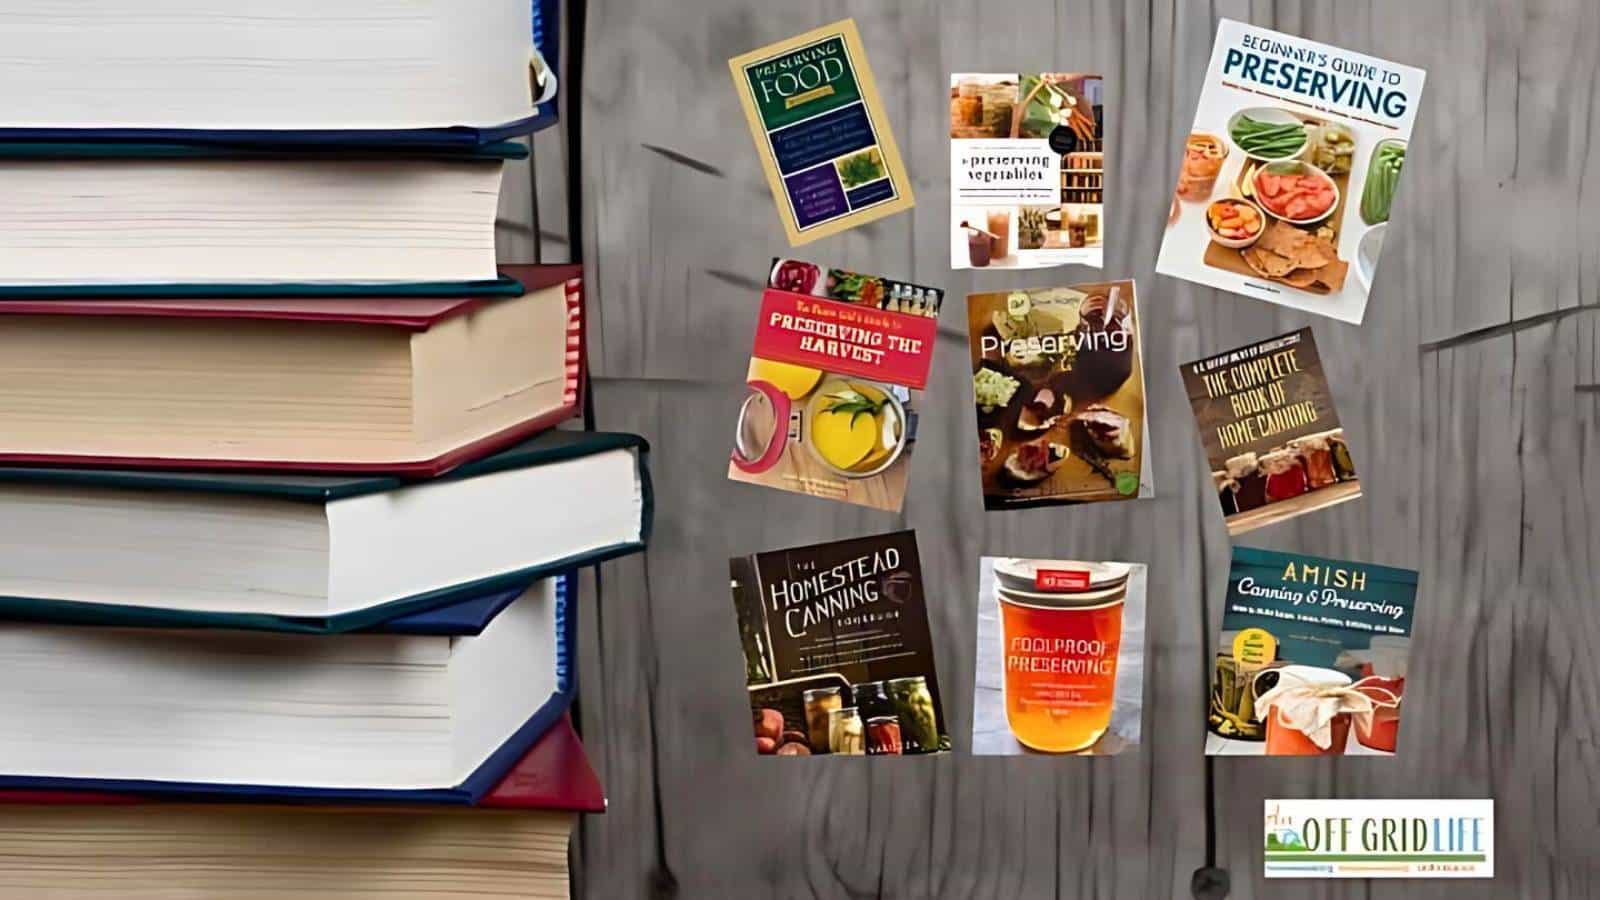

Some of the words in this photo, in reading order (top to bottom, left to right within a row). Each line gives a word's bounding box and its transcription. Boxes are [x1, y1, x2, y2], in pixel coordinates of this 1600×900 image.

[760, 57, 844, 103] FOOD
[1223, 47, 1407, 118] PRESERVING
[1382, 70, 1401, 86] TO
[769, 312, 882, 346] PRESERVING
[887, 335, 922, 354] THE
[800, 336, 885, 365] HARVEST
[981, 330, 1128, 359] Preserving
[1202, 371, 1232, 399] THE
[1231, 349, 1302, 390] COMPLETE
[1269, 379, 1289, 404] OF
[1216, 419, 1259, 449] HOME
[1257, 400, 1318, 436] CANNING
[770, 548, 900, 611] HOMESTEAD
[1281, 561, 1367, 591] AMISH
[785, 580, 879, 638] CANNING
[1238, 577, 1303, 605] Canning
[1306, 590, 1318, 604] &
[1321, 588, 1404, 619] Preserving
[1008, 656, 1112, 675] PRESERVING
[1011, 637, 1107, 656] FOOLPROOF
